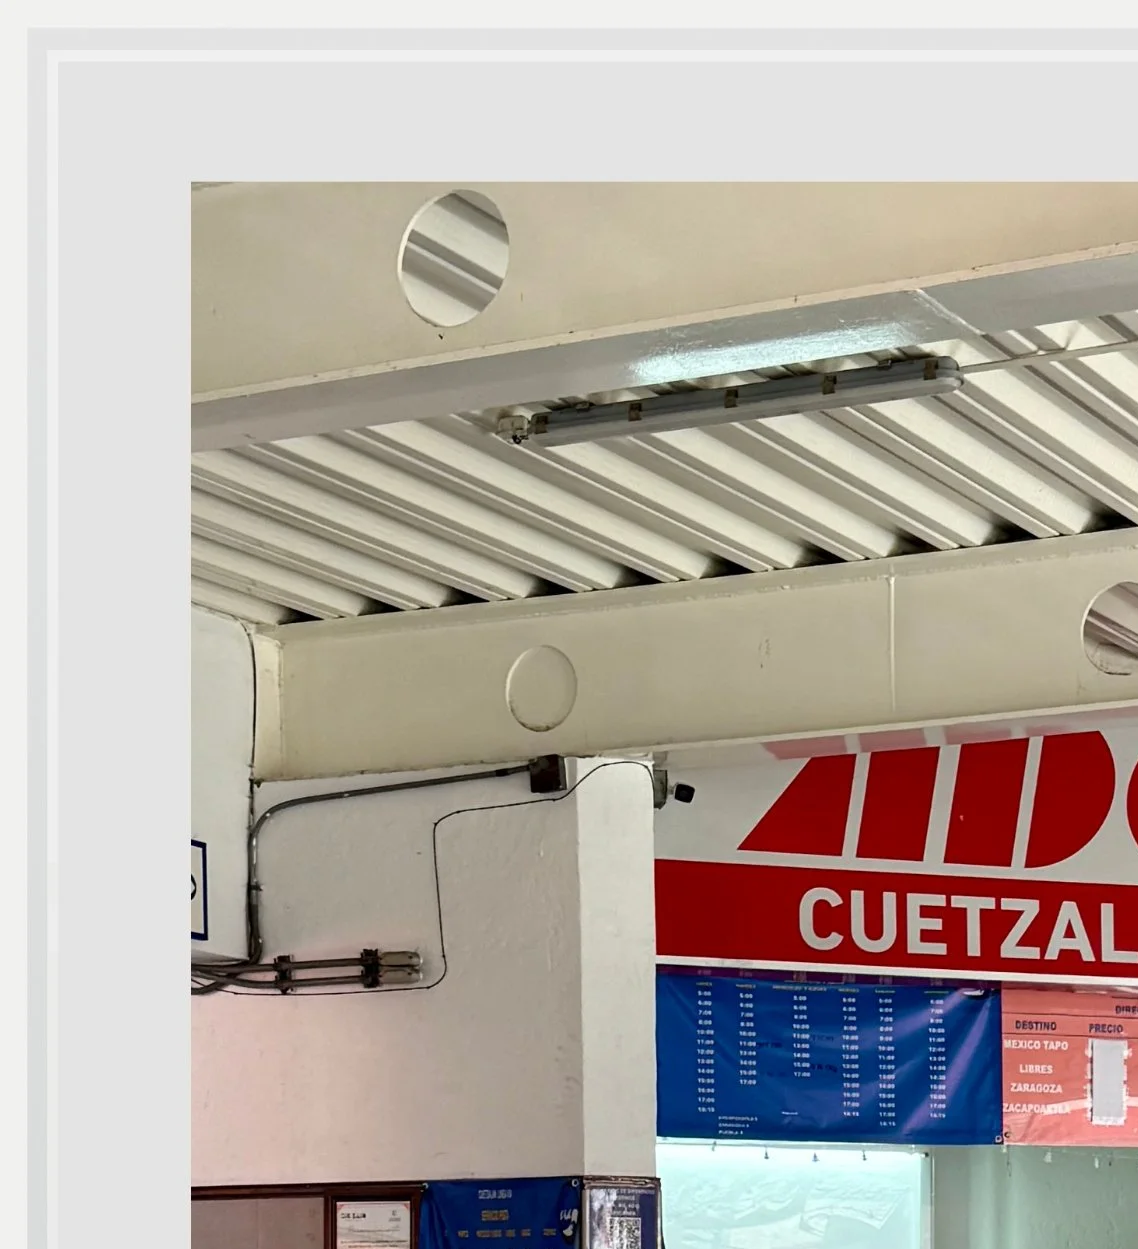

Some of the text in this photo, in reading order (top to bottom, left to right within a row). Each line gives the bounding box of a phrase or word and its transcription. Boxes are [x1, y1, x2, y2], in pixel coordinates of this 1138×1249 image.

[1015, 1020, 1057, 1031] DESTINO
[1089, 1024, 1123, 1033] PRECIO
[1004, 1040, 1069, 1051] MEXICO TAPO
[1019, 1064, 1053, 1074] LIBRES
[1010, 1083, 1063, 1093] ZARAGOZA
